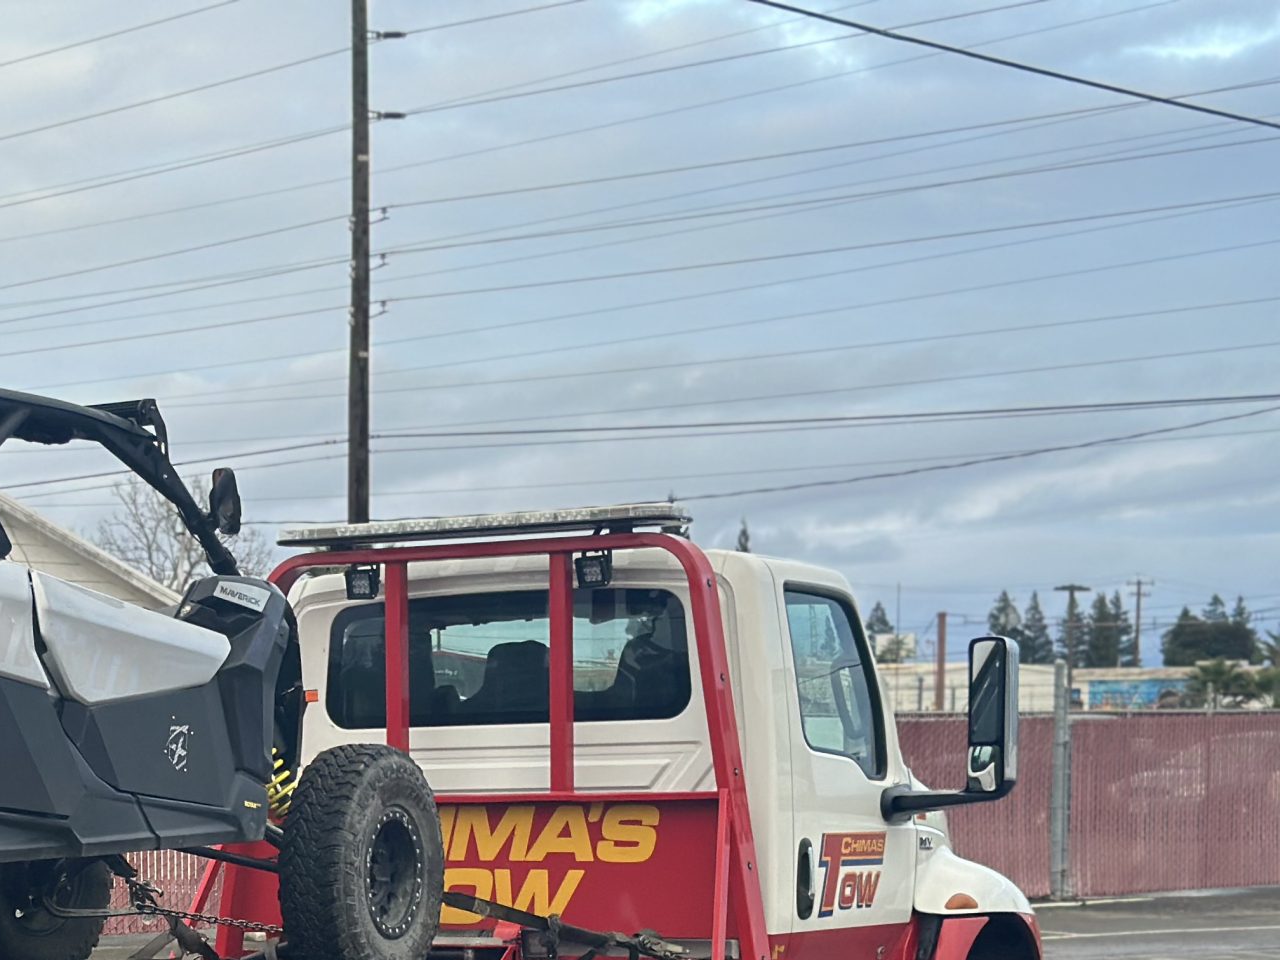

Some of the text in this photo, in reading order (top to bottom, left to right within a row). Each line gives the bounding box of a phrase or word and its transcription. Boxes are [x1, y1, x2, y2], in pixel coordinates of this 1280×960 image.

[219, 586, 261, 607] MAVERICK
[440, 802, 661, 863] IMA'S
[440, 867, 586, 925] OW
